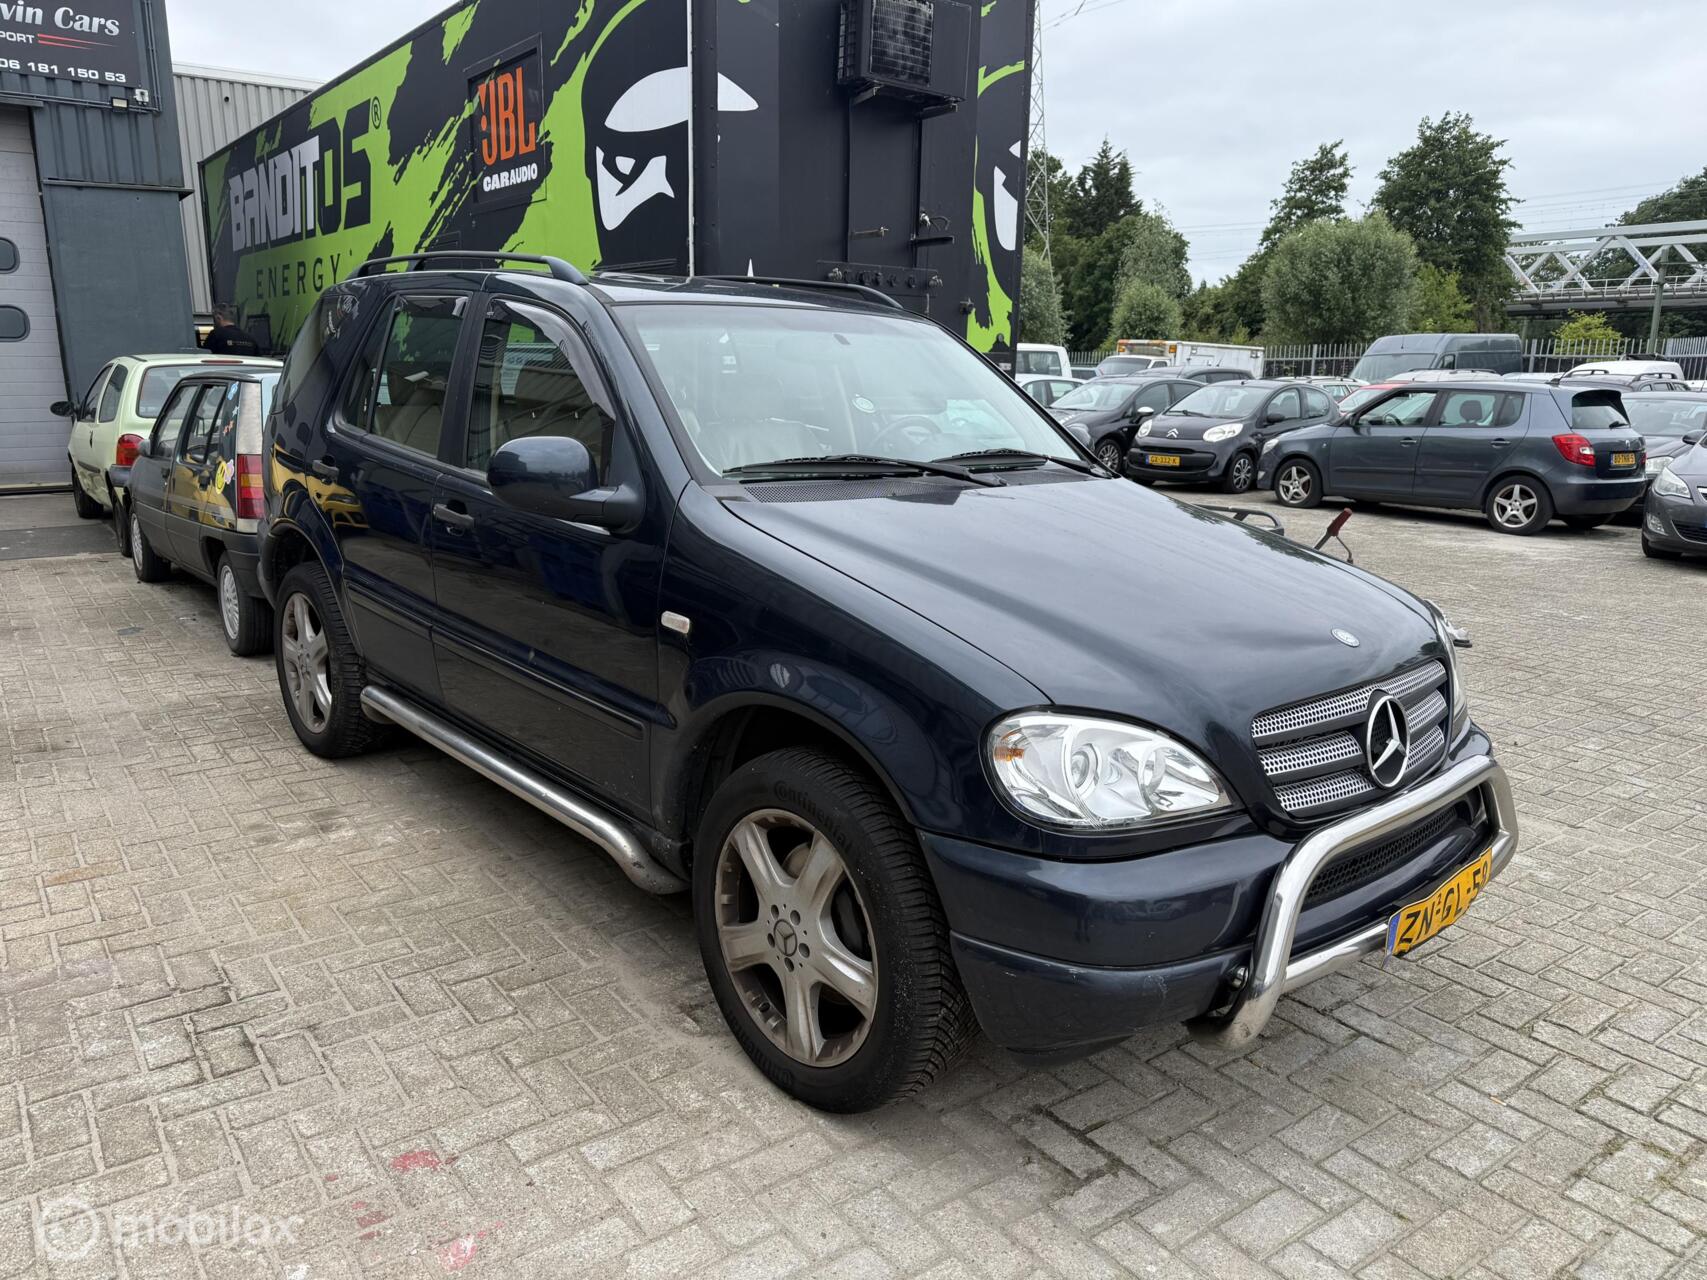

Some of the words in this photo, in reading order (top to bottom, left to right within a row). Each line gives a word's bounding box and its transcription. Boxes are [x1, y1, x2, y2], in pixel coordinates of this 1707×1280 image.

[54, 7, 120, 36] Cars
[0, 58, 20, 69] 06
[27, 62, 58, 74] 181
[67, 67, 99, 79] 150
[105, 72, 126, 83] 53
[478, 66, 536, 166] JBL
[229, 98, 371, 252] BANDITOS
[256, 253, 340, 299] ENERGY
